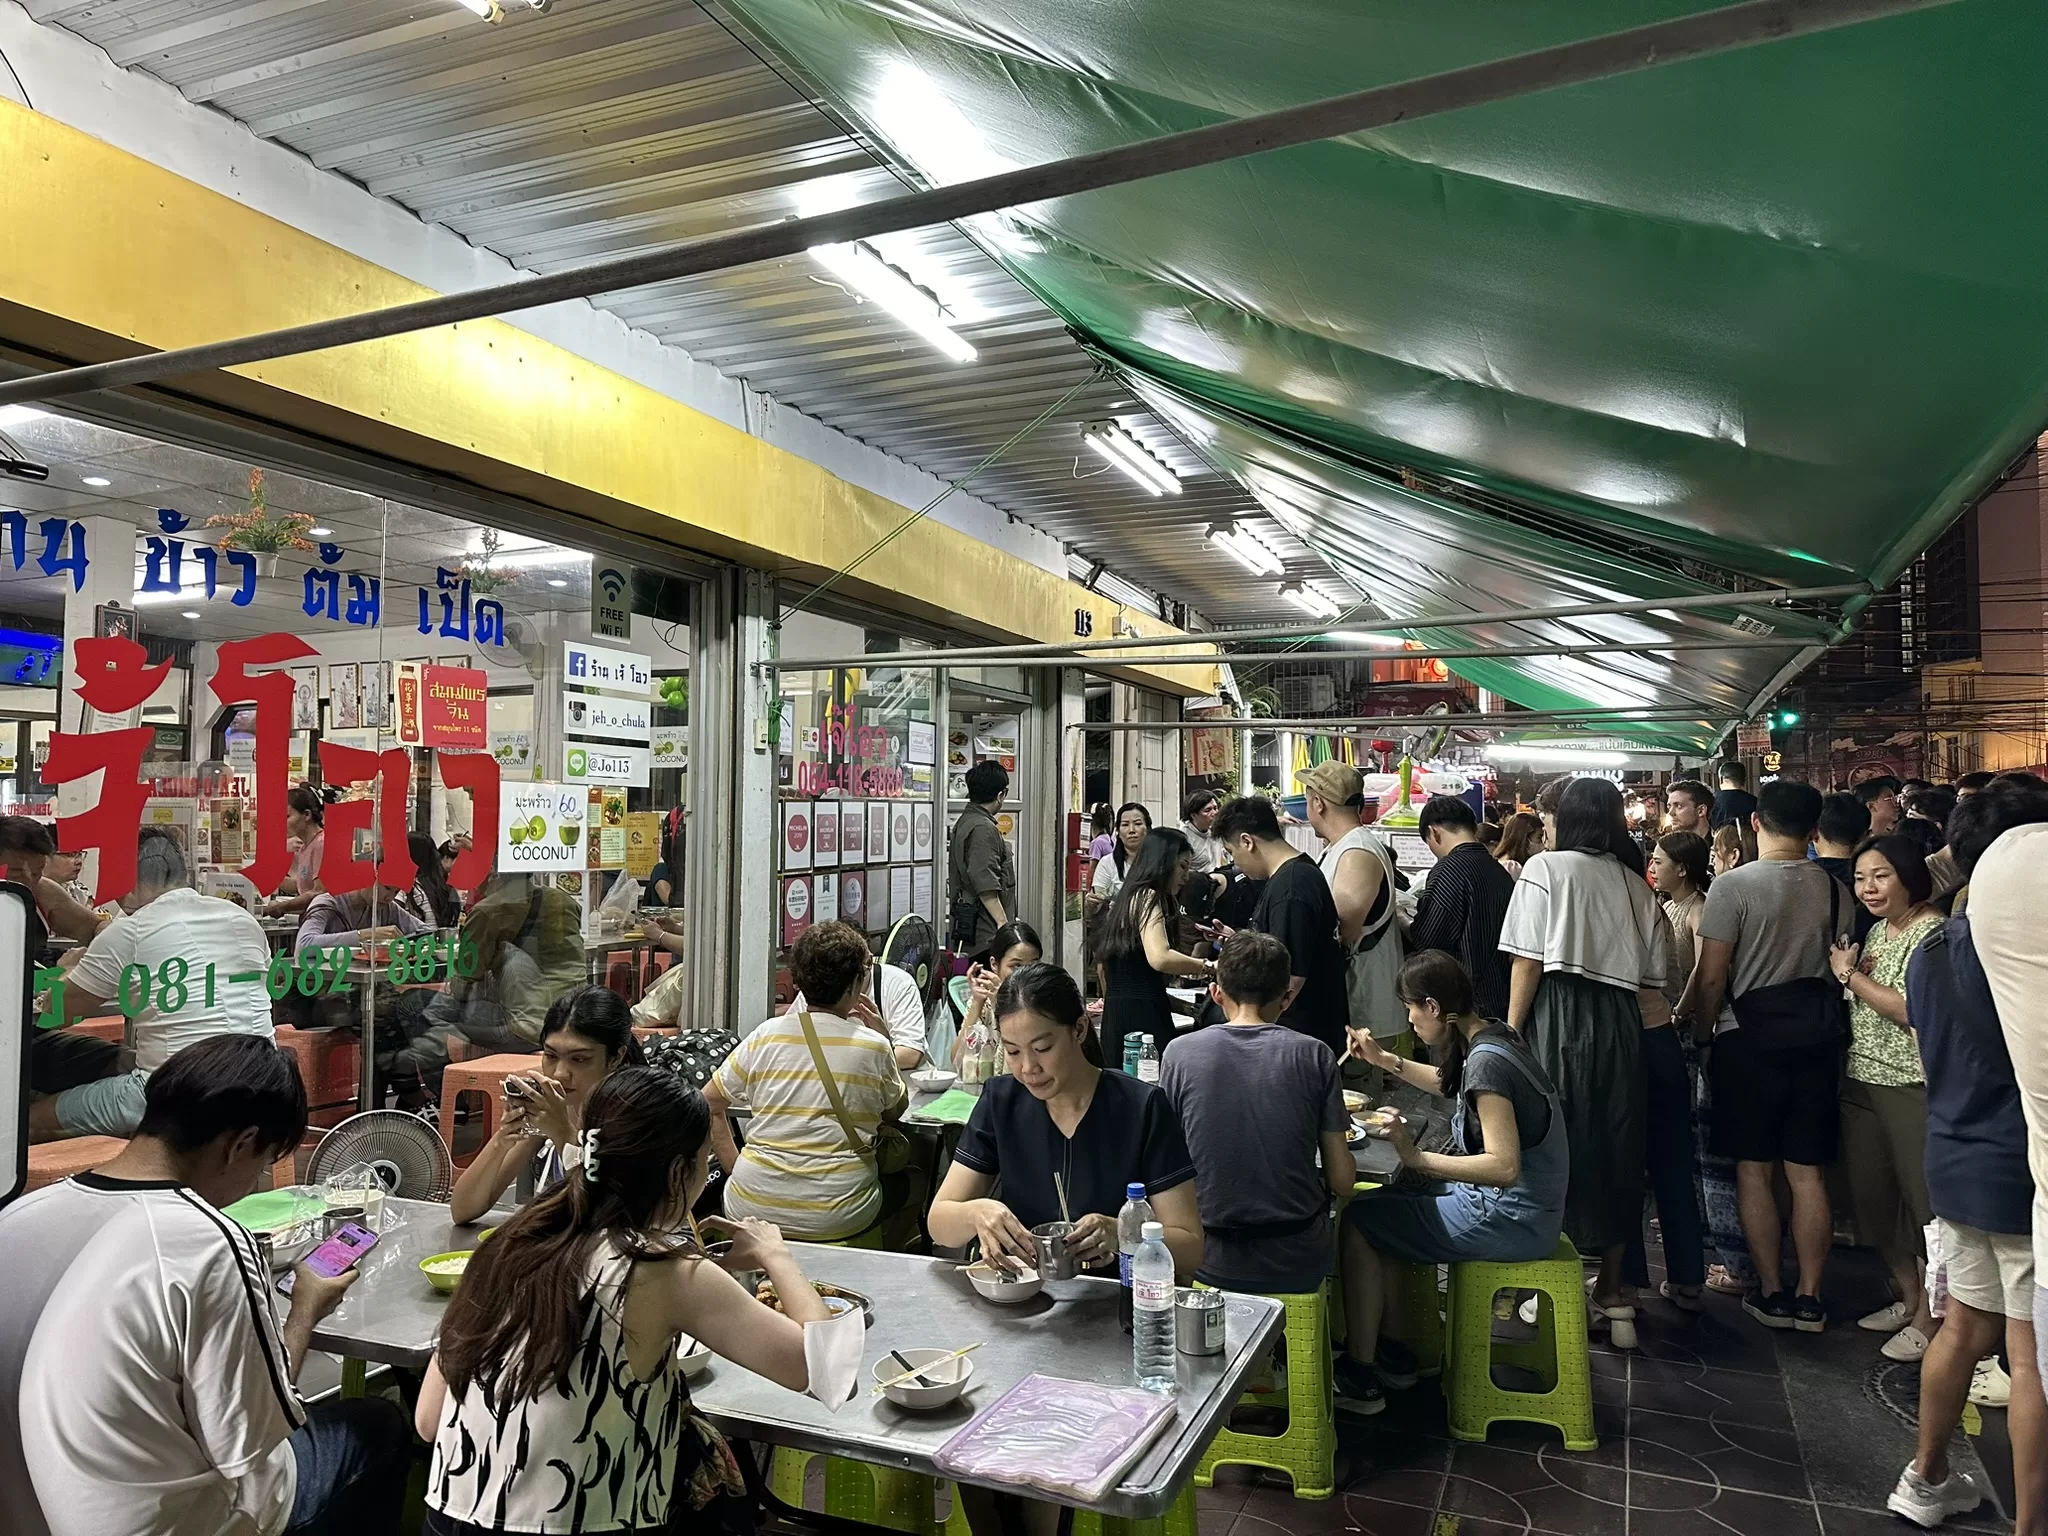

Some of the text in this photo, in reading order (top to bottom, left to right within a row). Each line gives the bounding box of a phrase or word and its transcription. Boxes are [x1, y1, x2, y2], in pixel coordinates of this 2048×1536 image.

[140, 508, 257, 607] ข้าว
[302, 543, 381, 629] ต้ม
[417, 565, 504, 647] เป็ด
[600, 607, 624, 621] FREE
[591, 659, 609, 680] ร้าน
[614, 663, 625, 681] เจ้
[630, 663, 648, 685] โอว
[429, 681, 486, 702] สมุนไพร
[446, 699, 469, 720] จีน
[591, 709, 646, 729] jeh_o_chula
[798, 760, 904, 797] 064-118-5888
[515, 793, 577, 813] มะพร้าว 60
[512, 846, 578, 860] COCONUT
